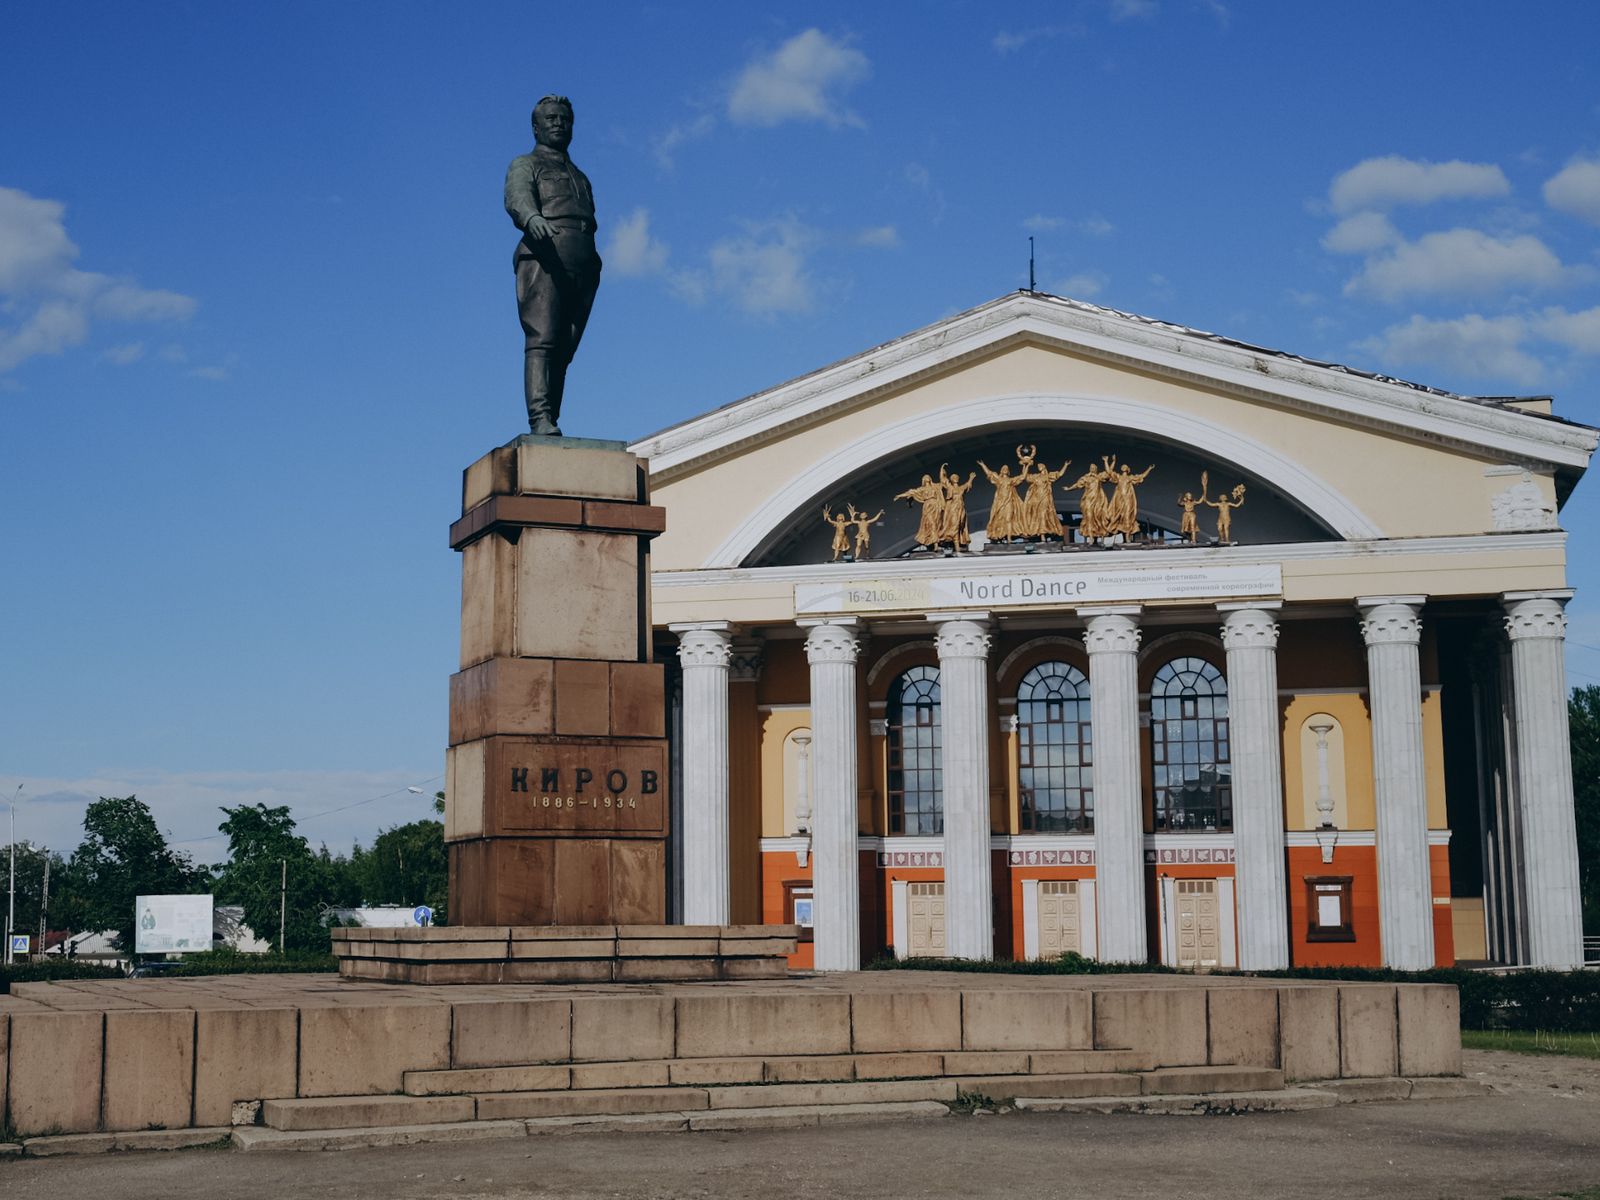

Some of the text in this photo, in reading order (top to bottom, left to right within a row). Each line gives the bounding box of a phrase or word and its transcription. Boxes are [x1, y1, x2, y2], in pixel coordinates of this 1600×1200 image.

[1097, 573, 1208, 584] Международный фестиваль
[960, 578, 1087, 599] Nord Dance
[1166, 581, 1275, 593] современной хореографии
[510, 767, 659, 794] КИРОВ
